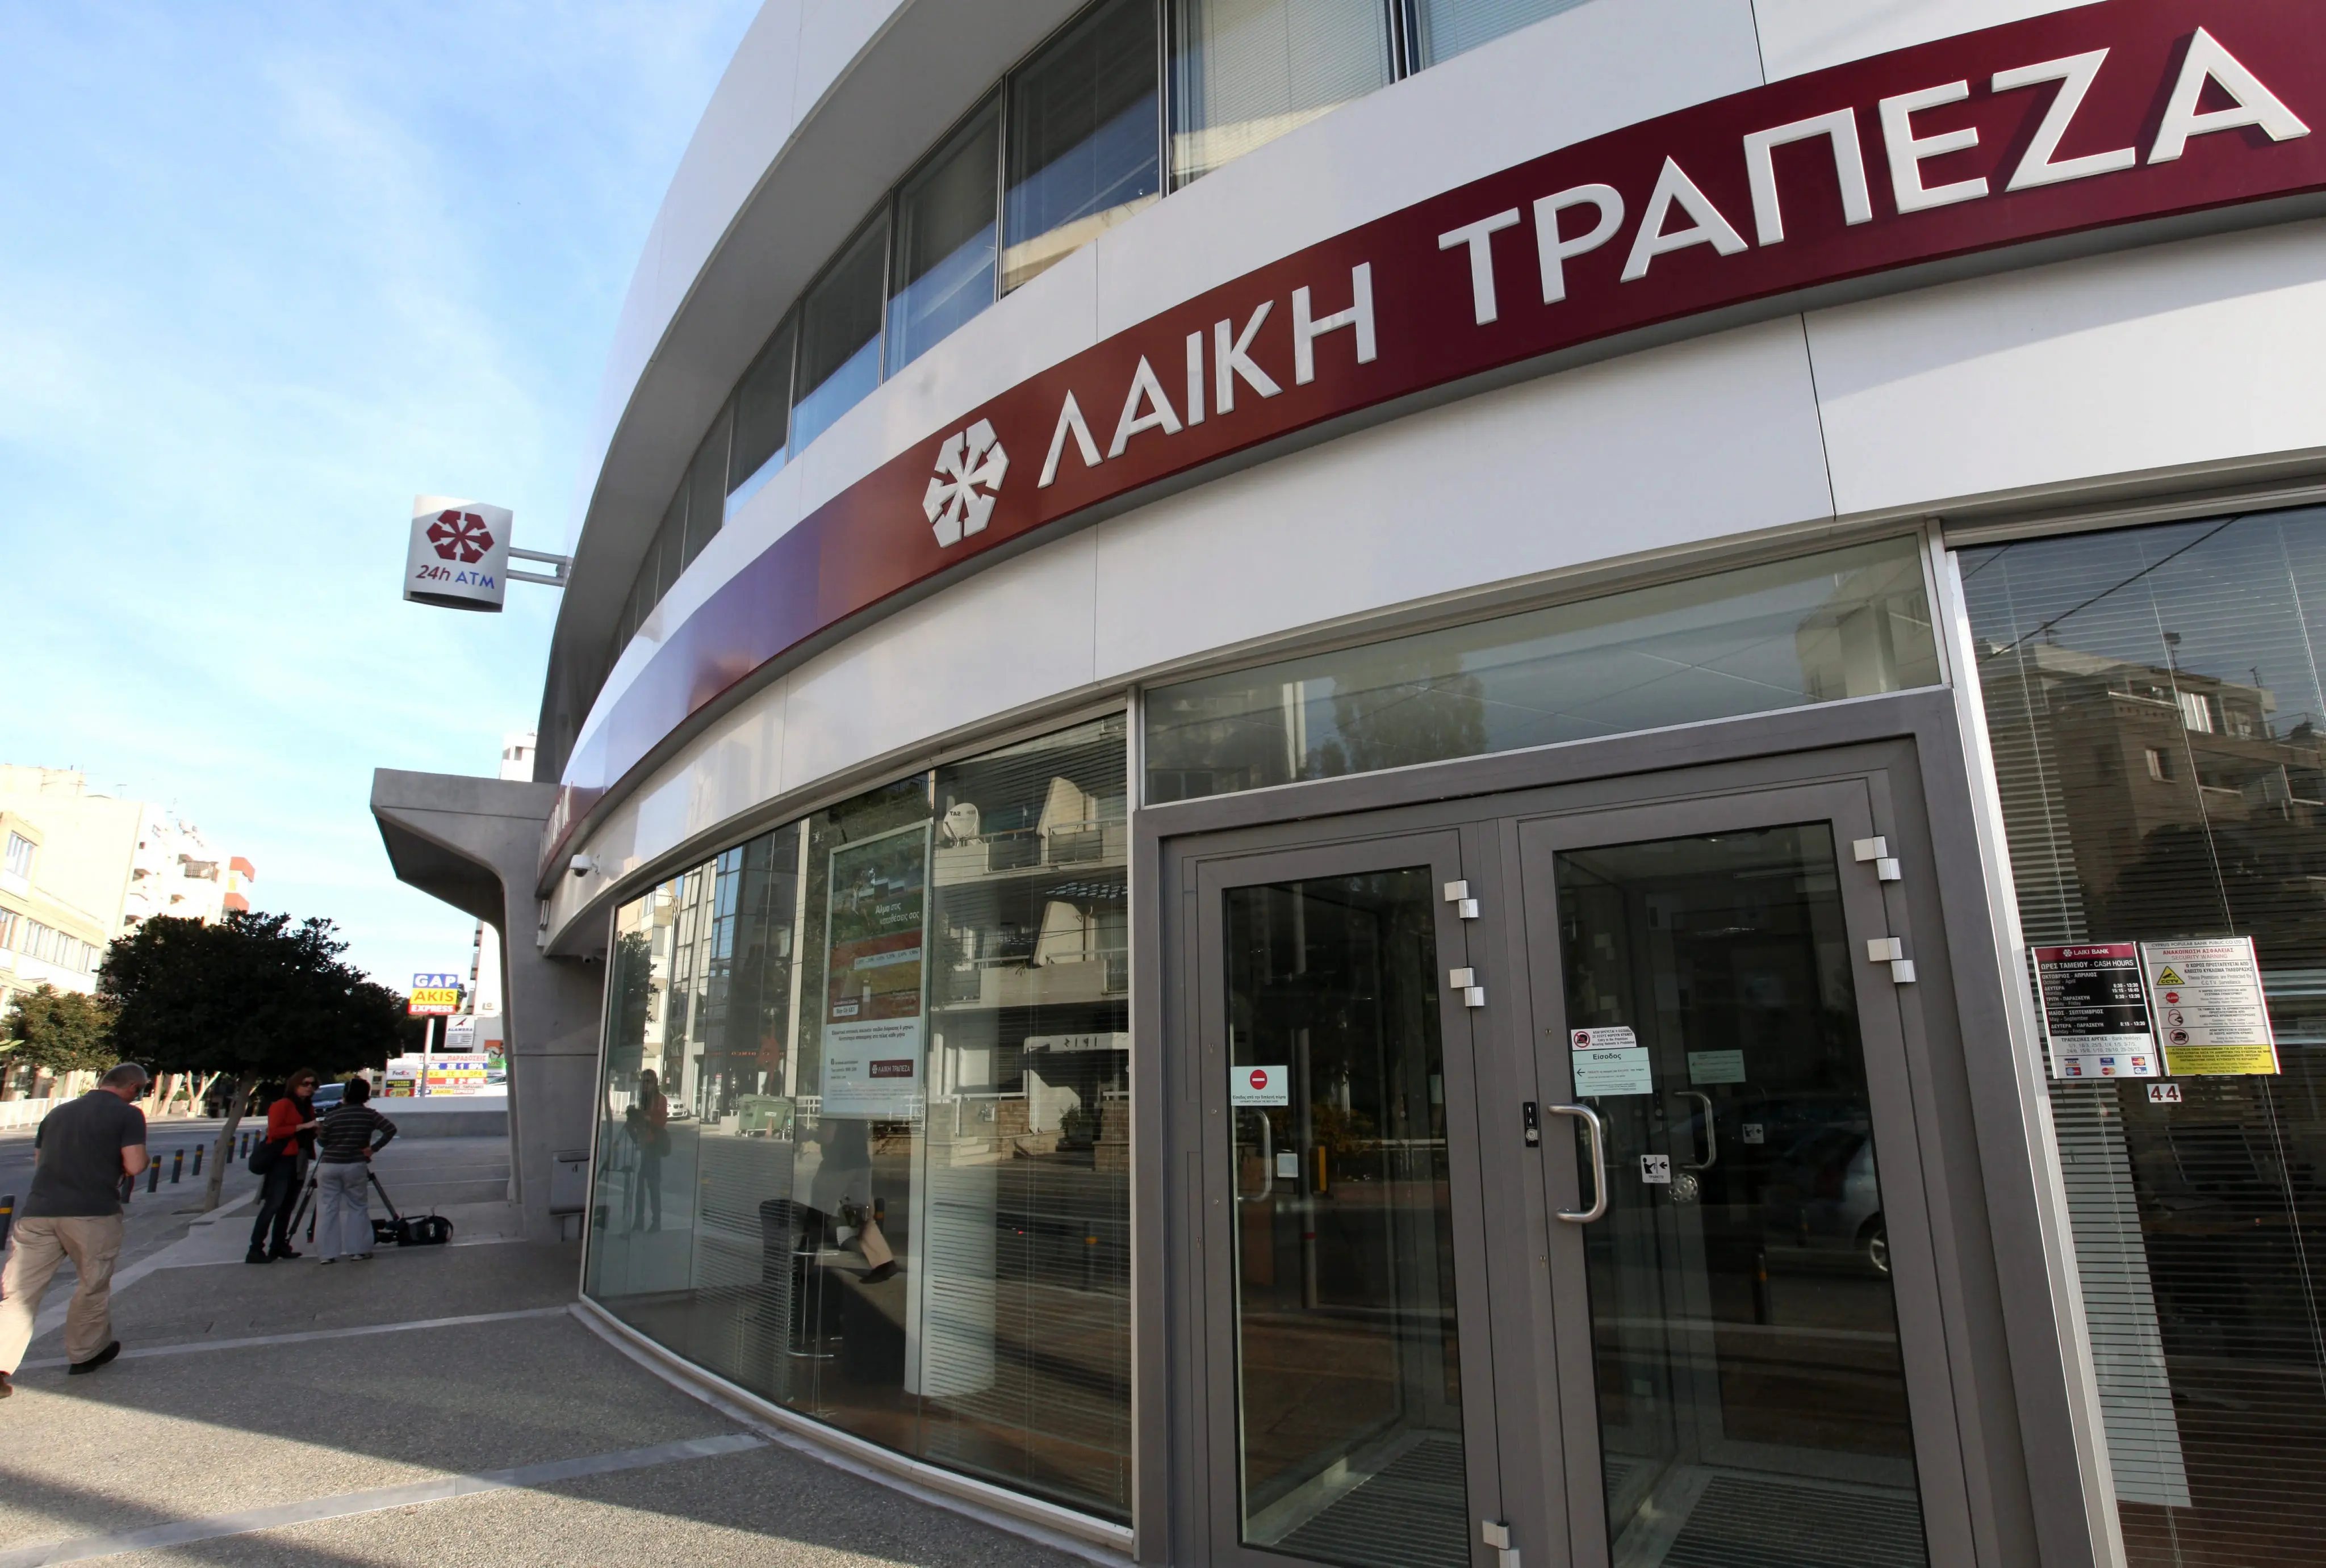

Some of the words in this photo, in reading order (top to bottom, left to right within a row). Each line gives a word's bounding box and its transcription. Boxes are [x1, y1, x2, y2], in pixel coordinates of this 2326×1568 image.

[1038, 262, 1377, 489] ΛΑΙΚΗ
[1438, 26, 2310, 326] ΤΡΑΠΕΖΑ
[415, 564, 451, 581] 24h
[455, 571, 495, 589] ATM
[415, 975, 456, 987] GAP
[413, 991, 454, 1001] AKIS
